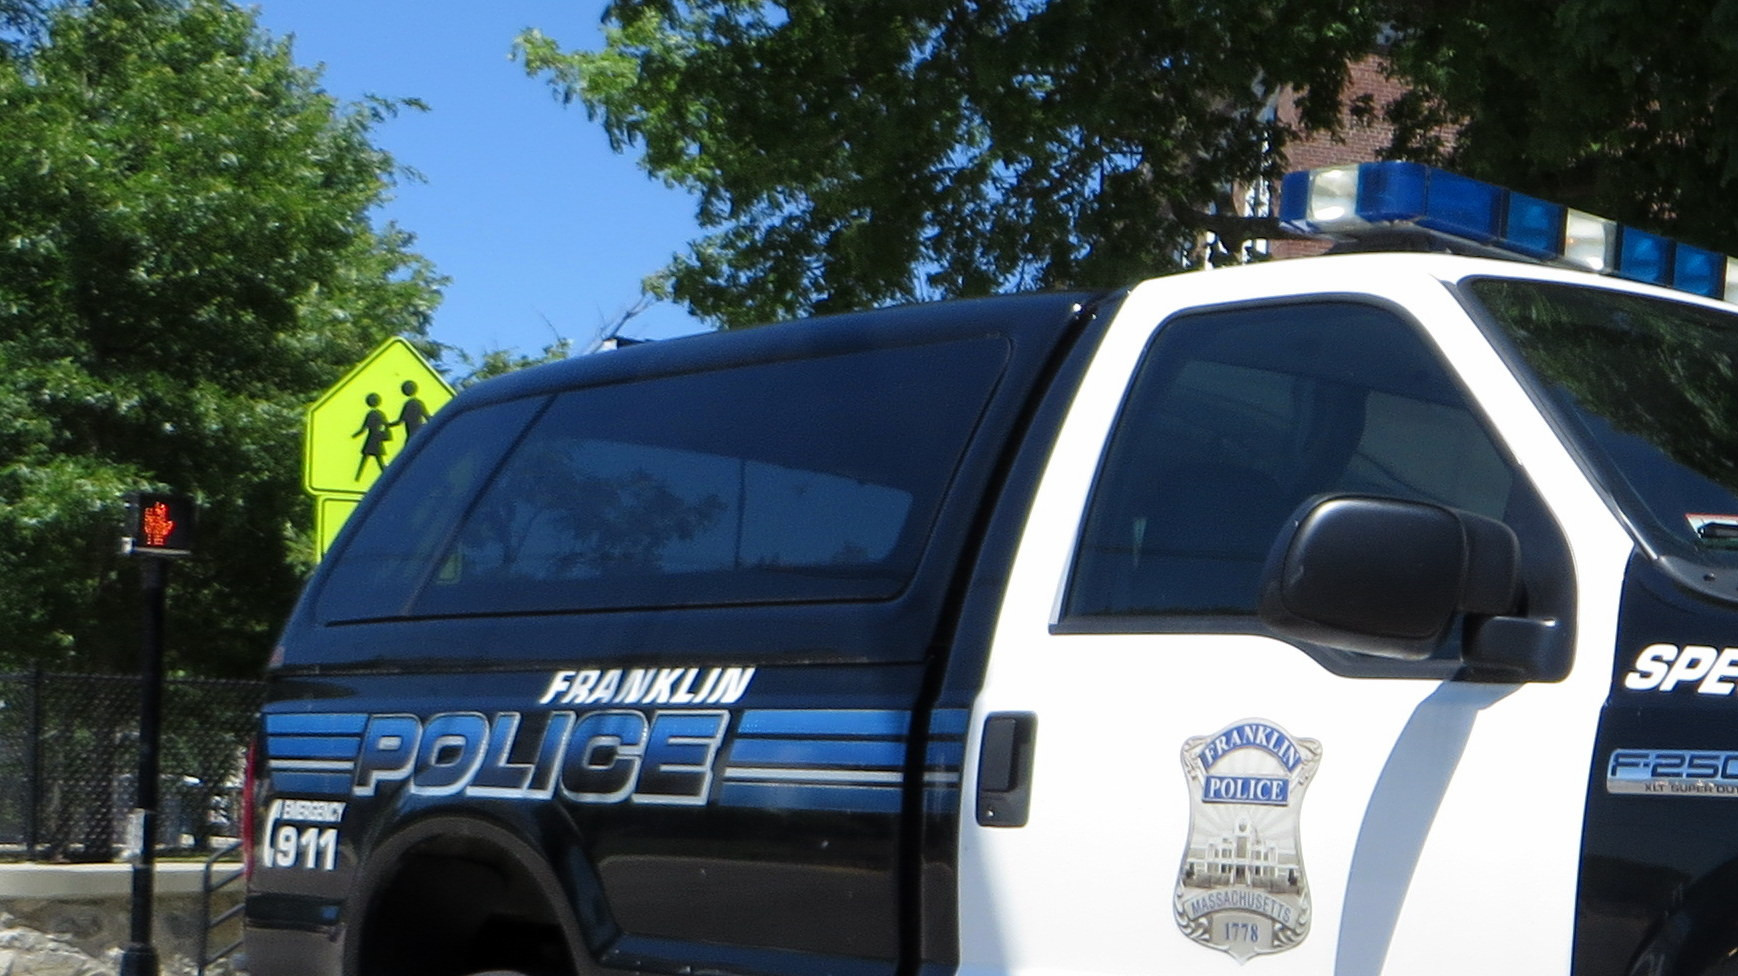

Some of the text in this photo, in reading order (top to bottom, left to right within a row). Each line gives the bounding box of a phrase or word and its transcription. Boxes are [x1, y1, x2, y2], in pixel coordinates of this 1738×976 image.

[541, 666, 755, 704] FRANKLIN
[353, 708, 730, 806] POLICE
[1204, 725, 1301, 769] FRANKLIN
[1210, 777, 1284, 801] POLICE
[1644, 783, 1665, 793] XLT
[1670, 783, 1714, 794] SUPER
[276, 825, 338, 871] 911
[1191, 890, 1292, 924] MASSACHUSETTS
[1224, 922, 1259, 943] 1778
